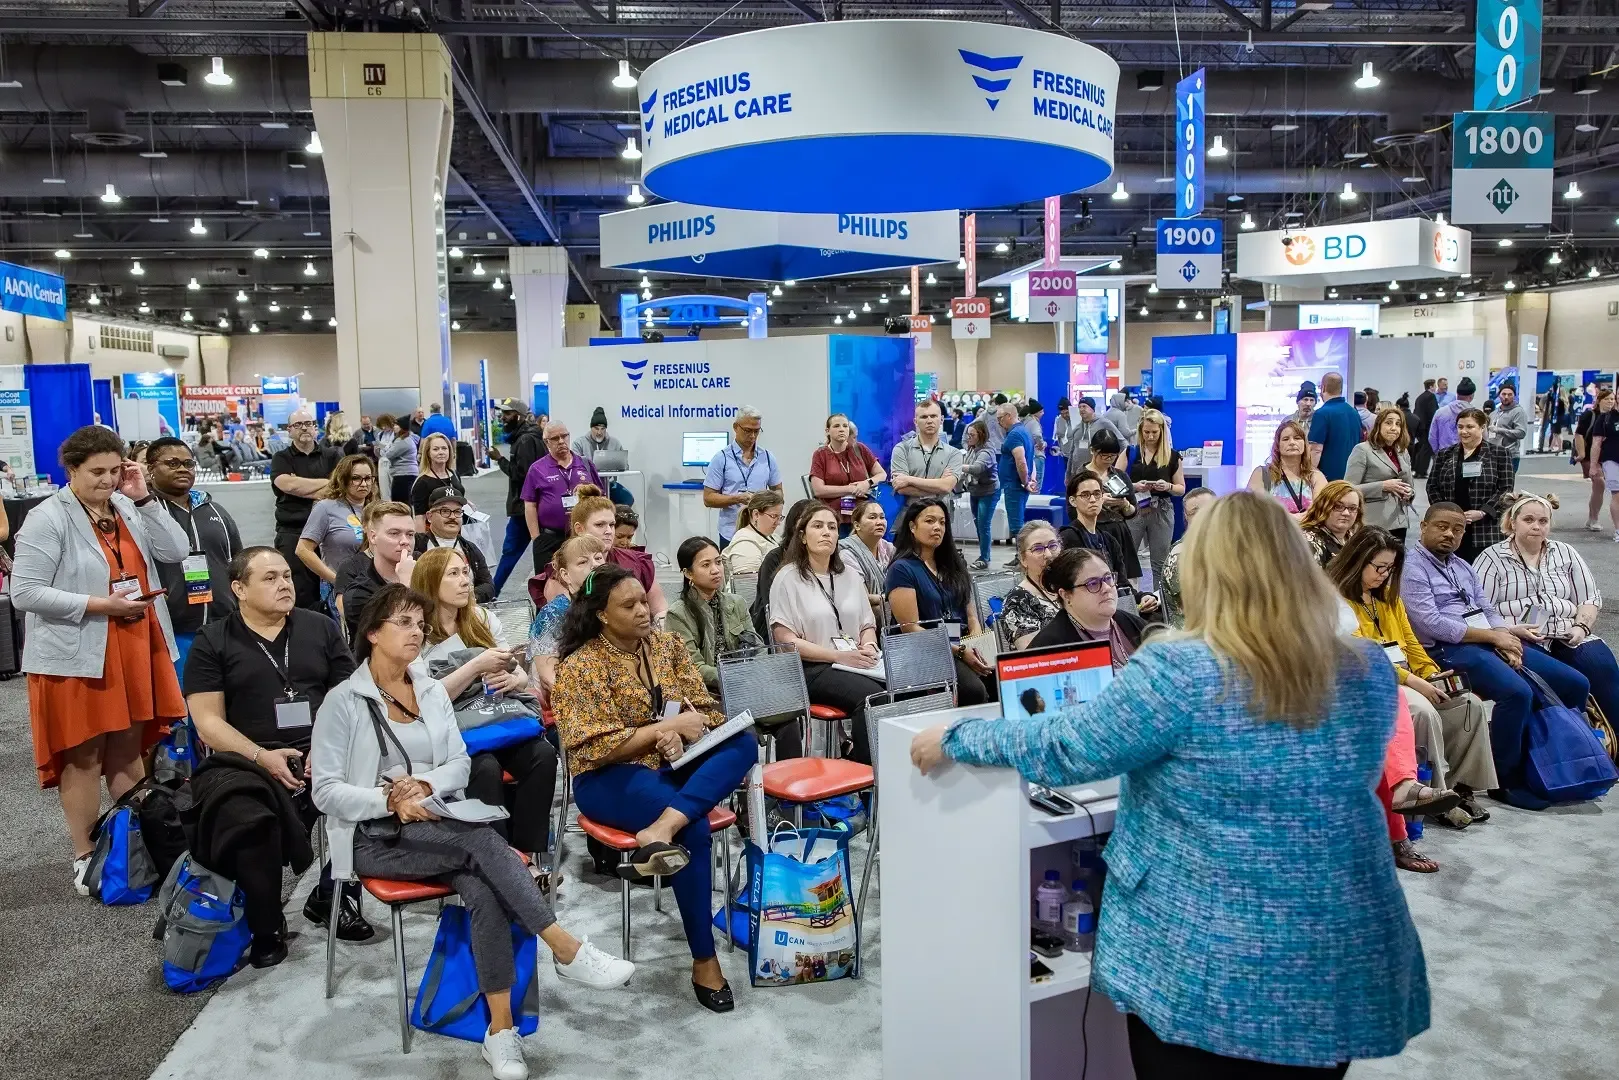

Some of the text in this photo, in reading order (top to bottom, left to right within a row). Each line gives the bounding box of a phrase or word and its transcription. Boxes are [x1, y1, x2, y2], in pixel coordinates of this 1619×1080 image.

[365, 67, 384, 81] HV
[663, 71, 751, 114] FRESENIUS
[1033, 69, 1105, 108] FRESENIUS
[664, 92, 792, 139] MEDICAL CARE
[1033, 96, 1096, 129] MEDICAL
[1185, 92, 1195, 210] 1900
[1465, 125, 1543, 155] 1800
[648, 214, 716, 244] PHILIPS
[838, 213, 908, 240] PHILIPS
[1164, 226, 1216, 246] 1900
[1324, 234, 1367, 260] BD
[4, 276, 64, 305] AACN Central
[1031, 276, 1073, 291] 2000
[955, 302, 986, 314] 2100
[910, 319, 928, 329] 200
[653, 362, 710, 375] FRESENIUS
[185, 387, 234, 396] RESOURCE
[654, 376, 731, 390] MEDICAL CARE
[621, 404, 664, 418] Medical
[752, 871, 761, 904] UCLA
[788, 936, 805, 945] CAN
